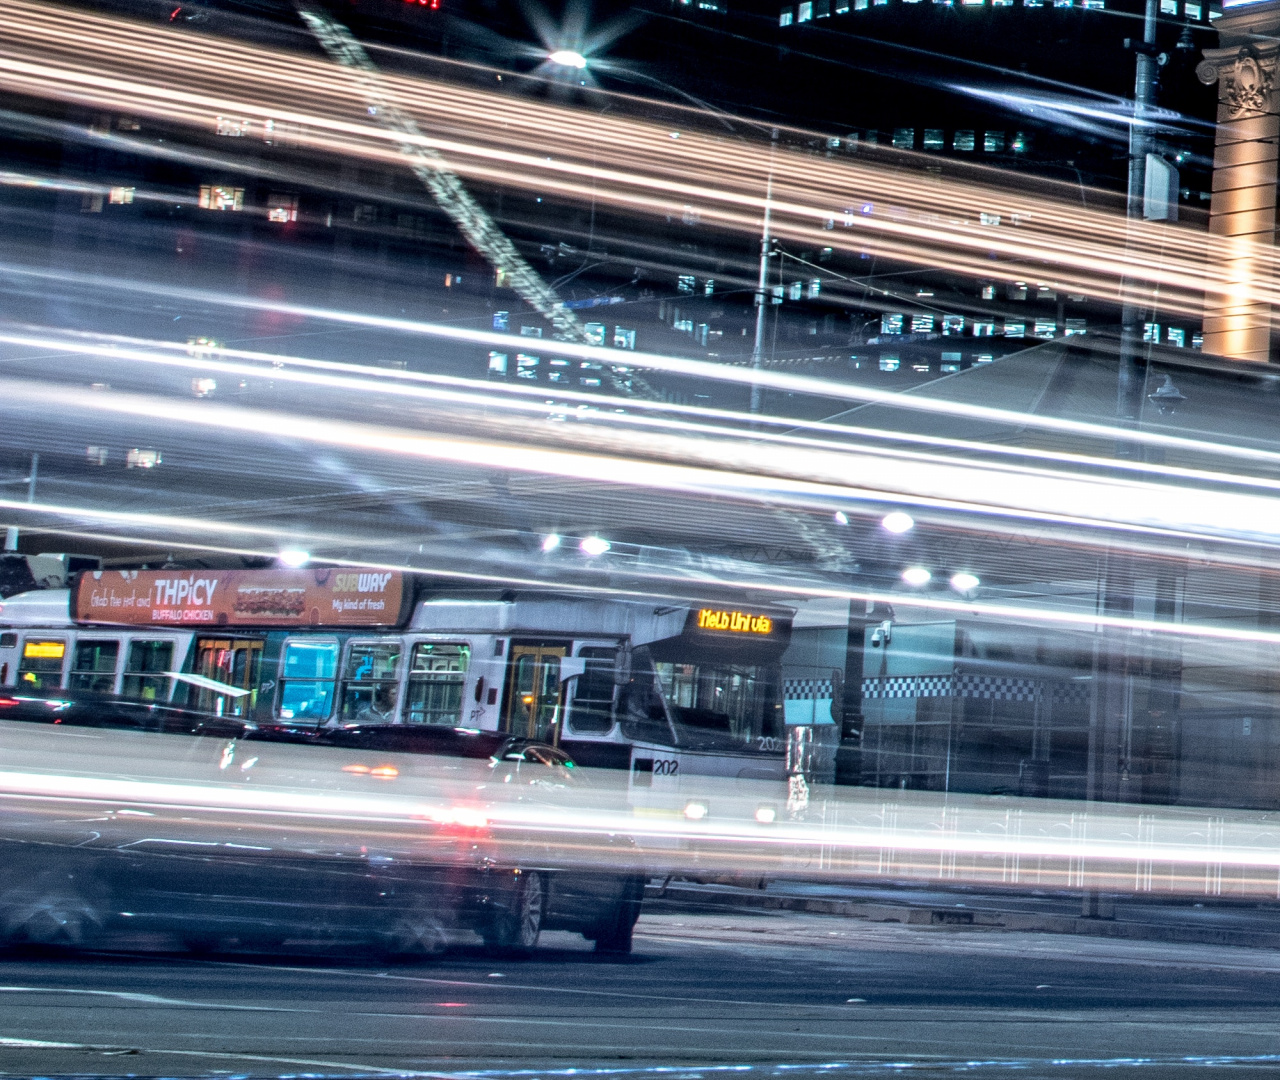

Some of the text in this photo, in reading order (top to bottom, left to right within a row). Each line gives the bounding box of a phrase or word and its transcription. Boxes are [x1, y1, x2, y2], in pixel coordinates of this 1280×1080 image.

[332, 572, 392, 593] SUBWAY
[332, 599, 385, 612] My kind of fresh
[152, 610, 214, 620] BUFFALO CHICKEN
[699, 609, 772, 633] Melb Uni via
[757, 736, 783, 751] 202
[655, 760, 679, 776] 202
